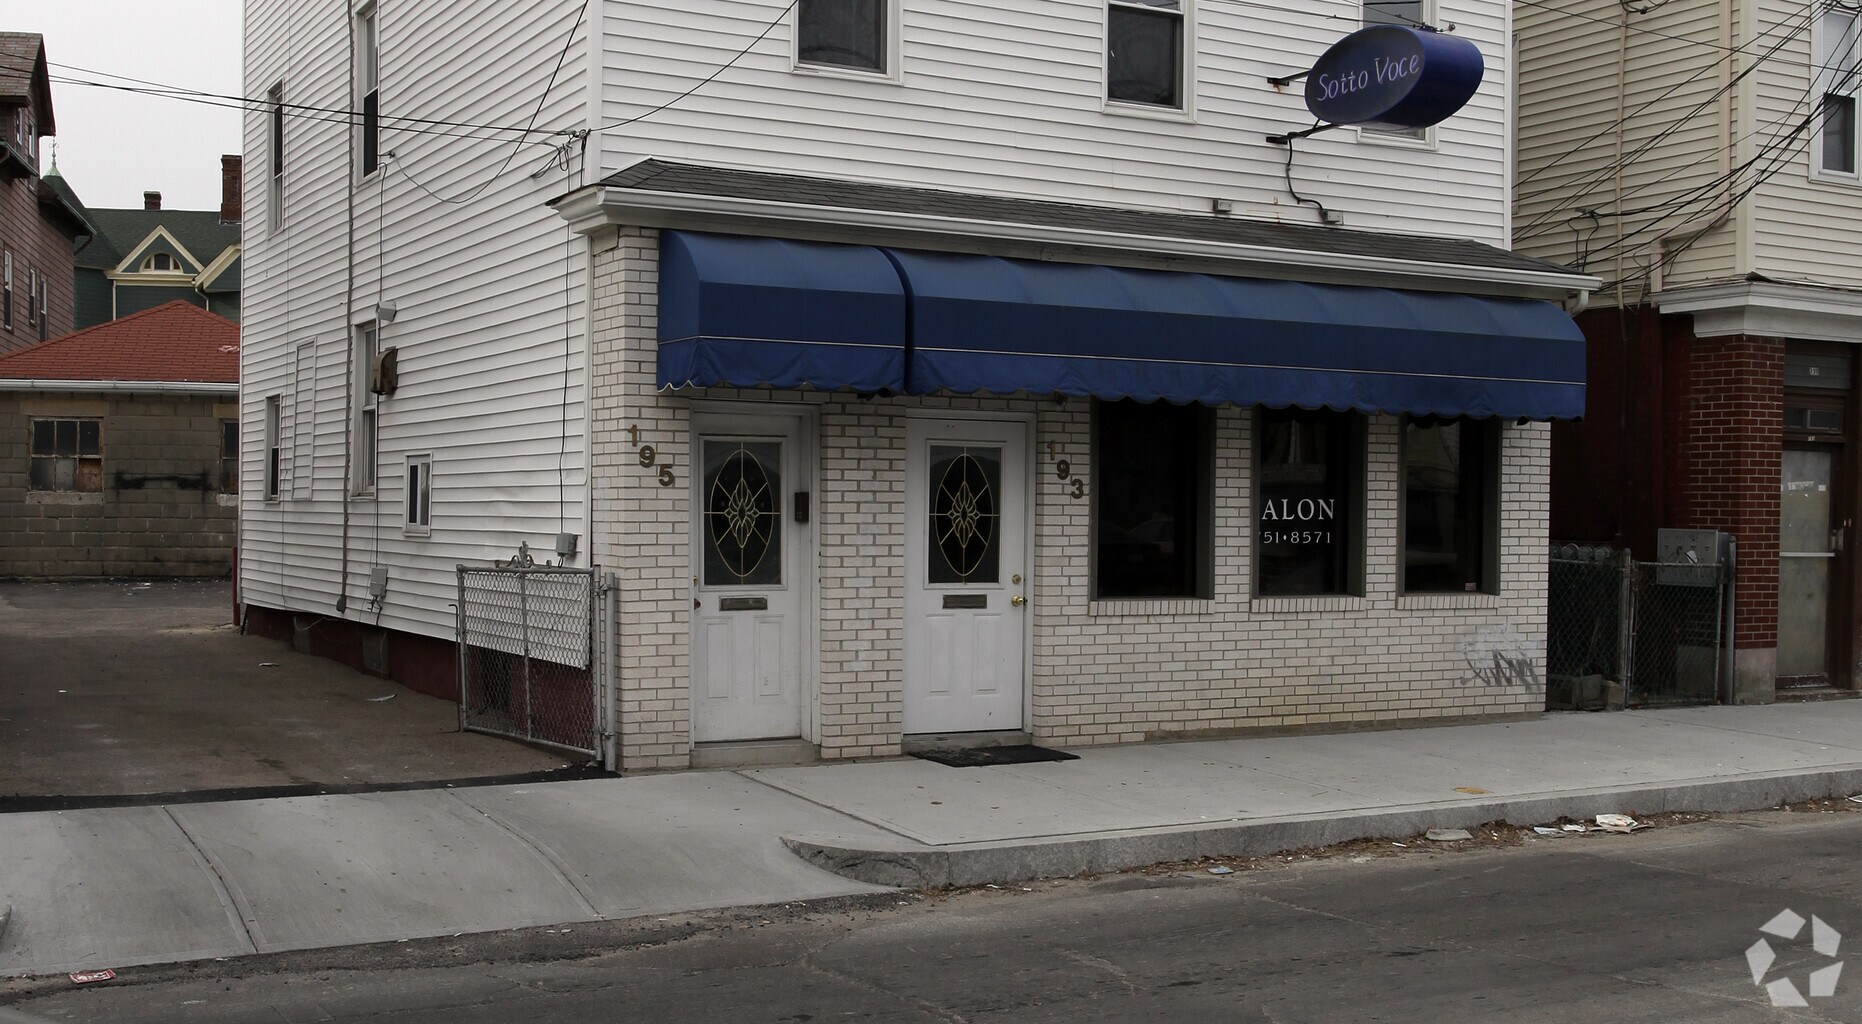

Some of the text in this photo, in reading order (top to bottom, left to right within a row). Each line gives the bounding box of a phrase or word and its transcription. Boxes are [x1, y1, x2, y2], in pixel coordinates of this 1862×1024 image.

[1317, 54, 1419, 101] Sotto Voce
[627, 424, 675, 487] 195
[1047, 440, 1084, 499] 193
[1261, 498, 1335, 520] ALON
